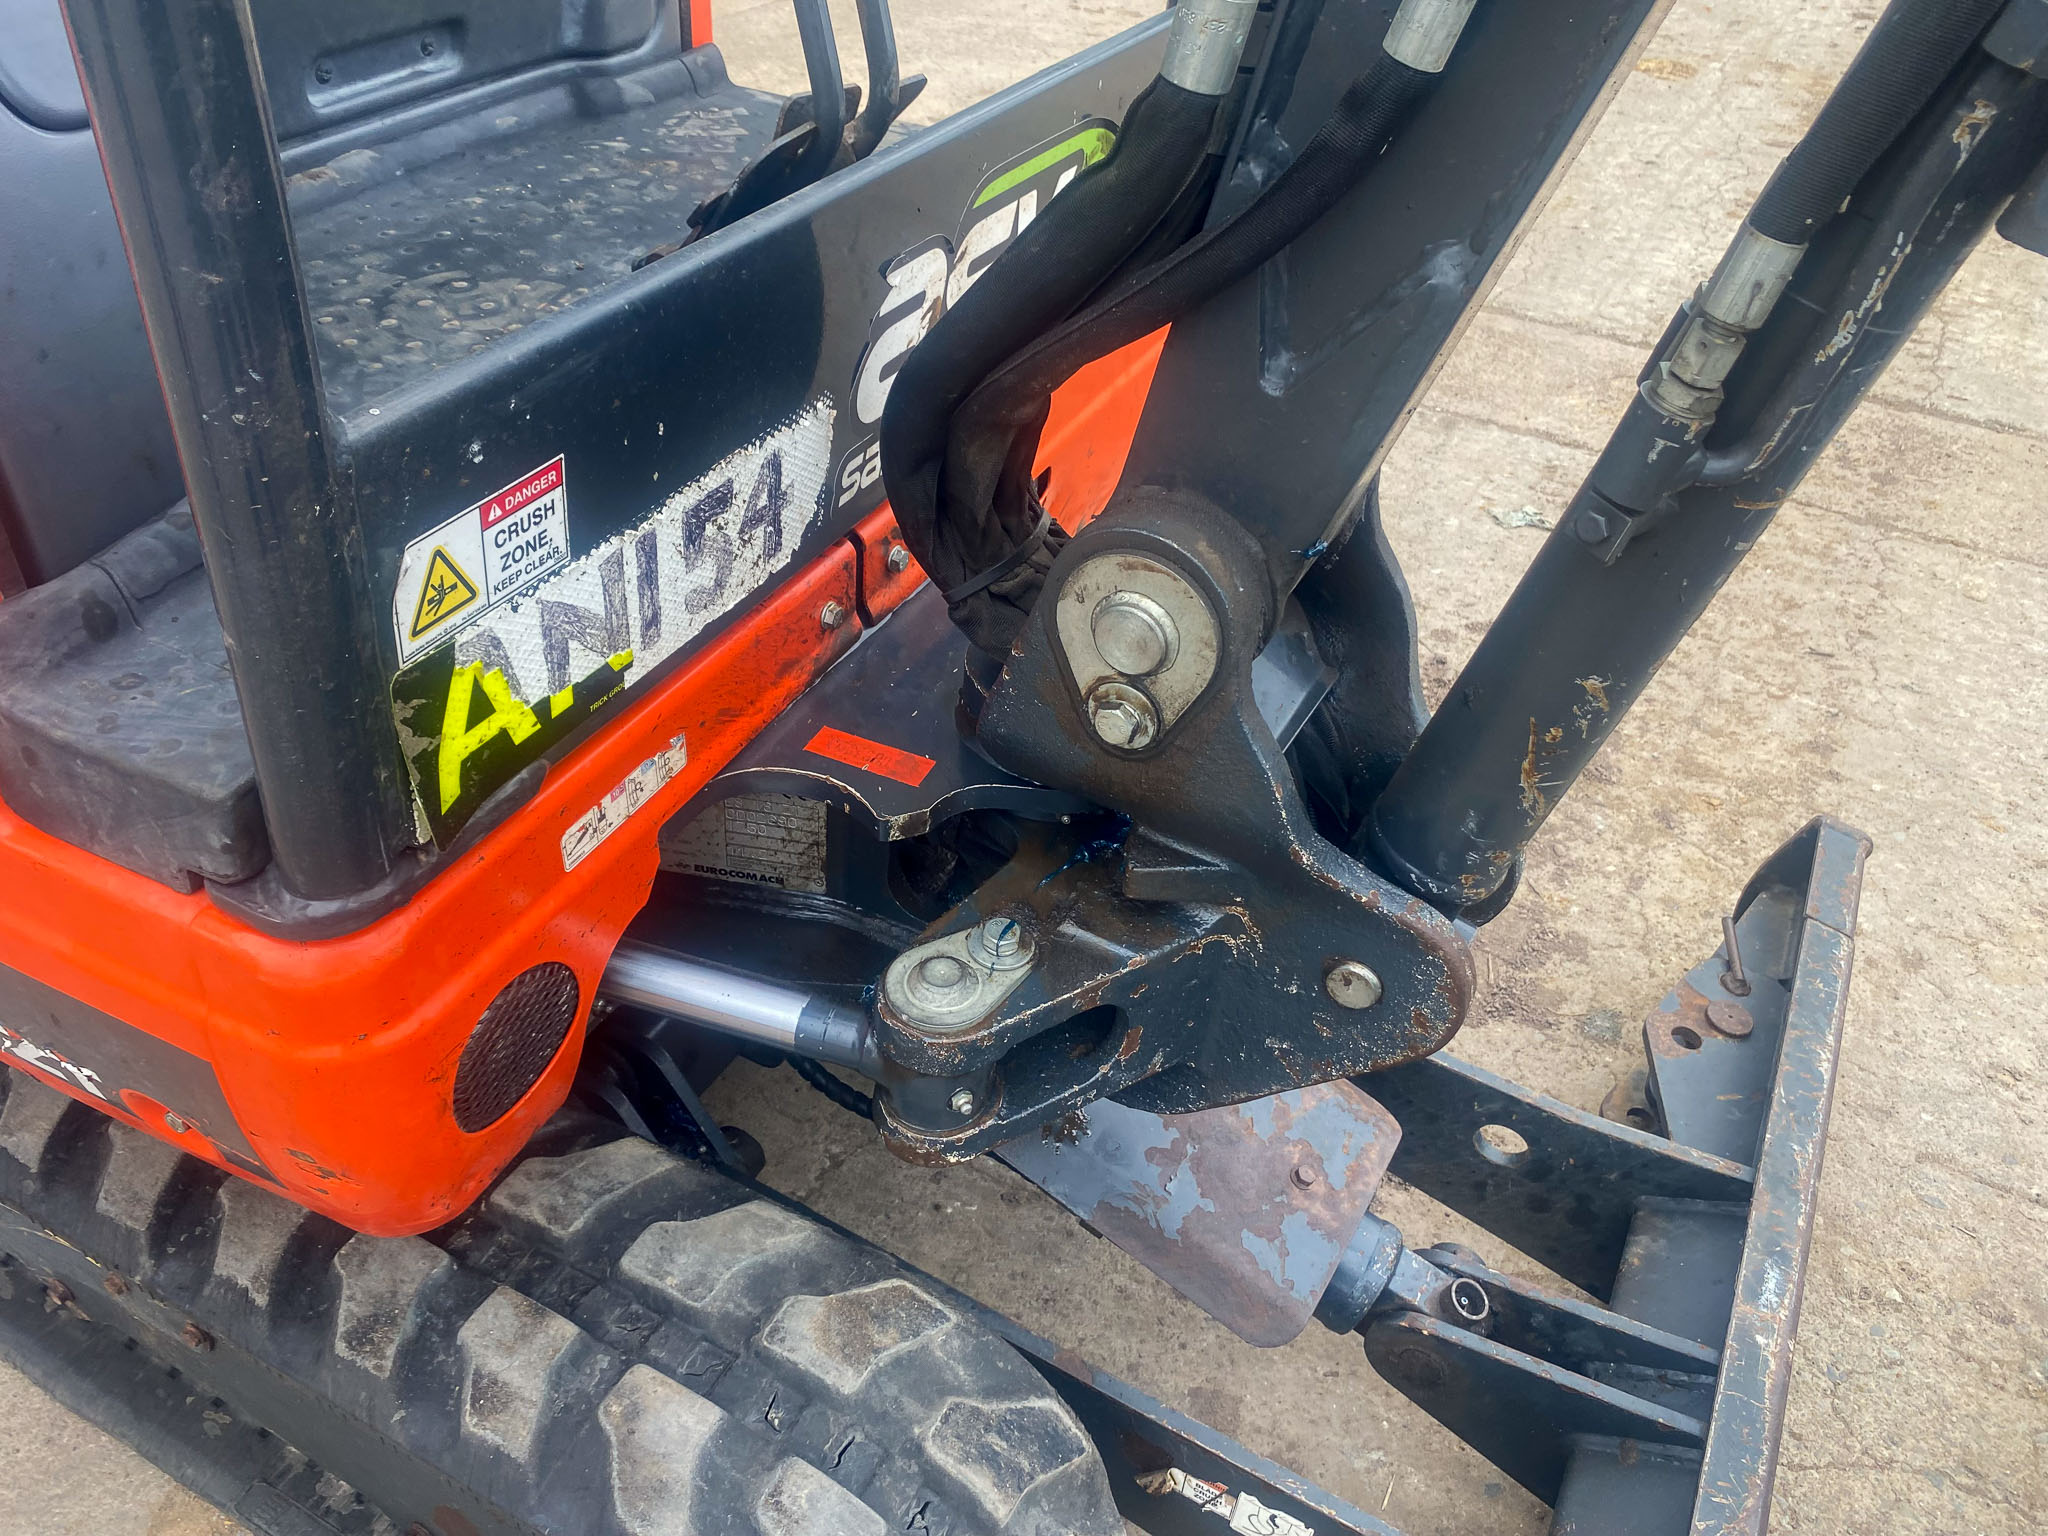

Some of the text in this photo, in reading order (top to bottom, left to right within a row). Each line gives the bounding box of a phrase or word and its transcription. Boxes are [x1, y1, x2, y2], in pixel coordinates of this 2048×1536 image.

[504, 470, 557, 510] DANGER
[494, 499, 556, 549] CRUSH
[493, 569, 523, 596] KEEP
[524, 545, 563, 575] CLEAR.
[693, 863, 785, 885] EUROCOMACH
